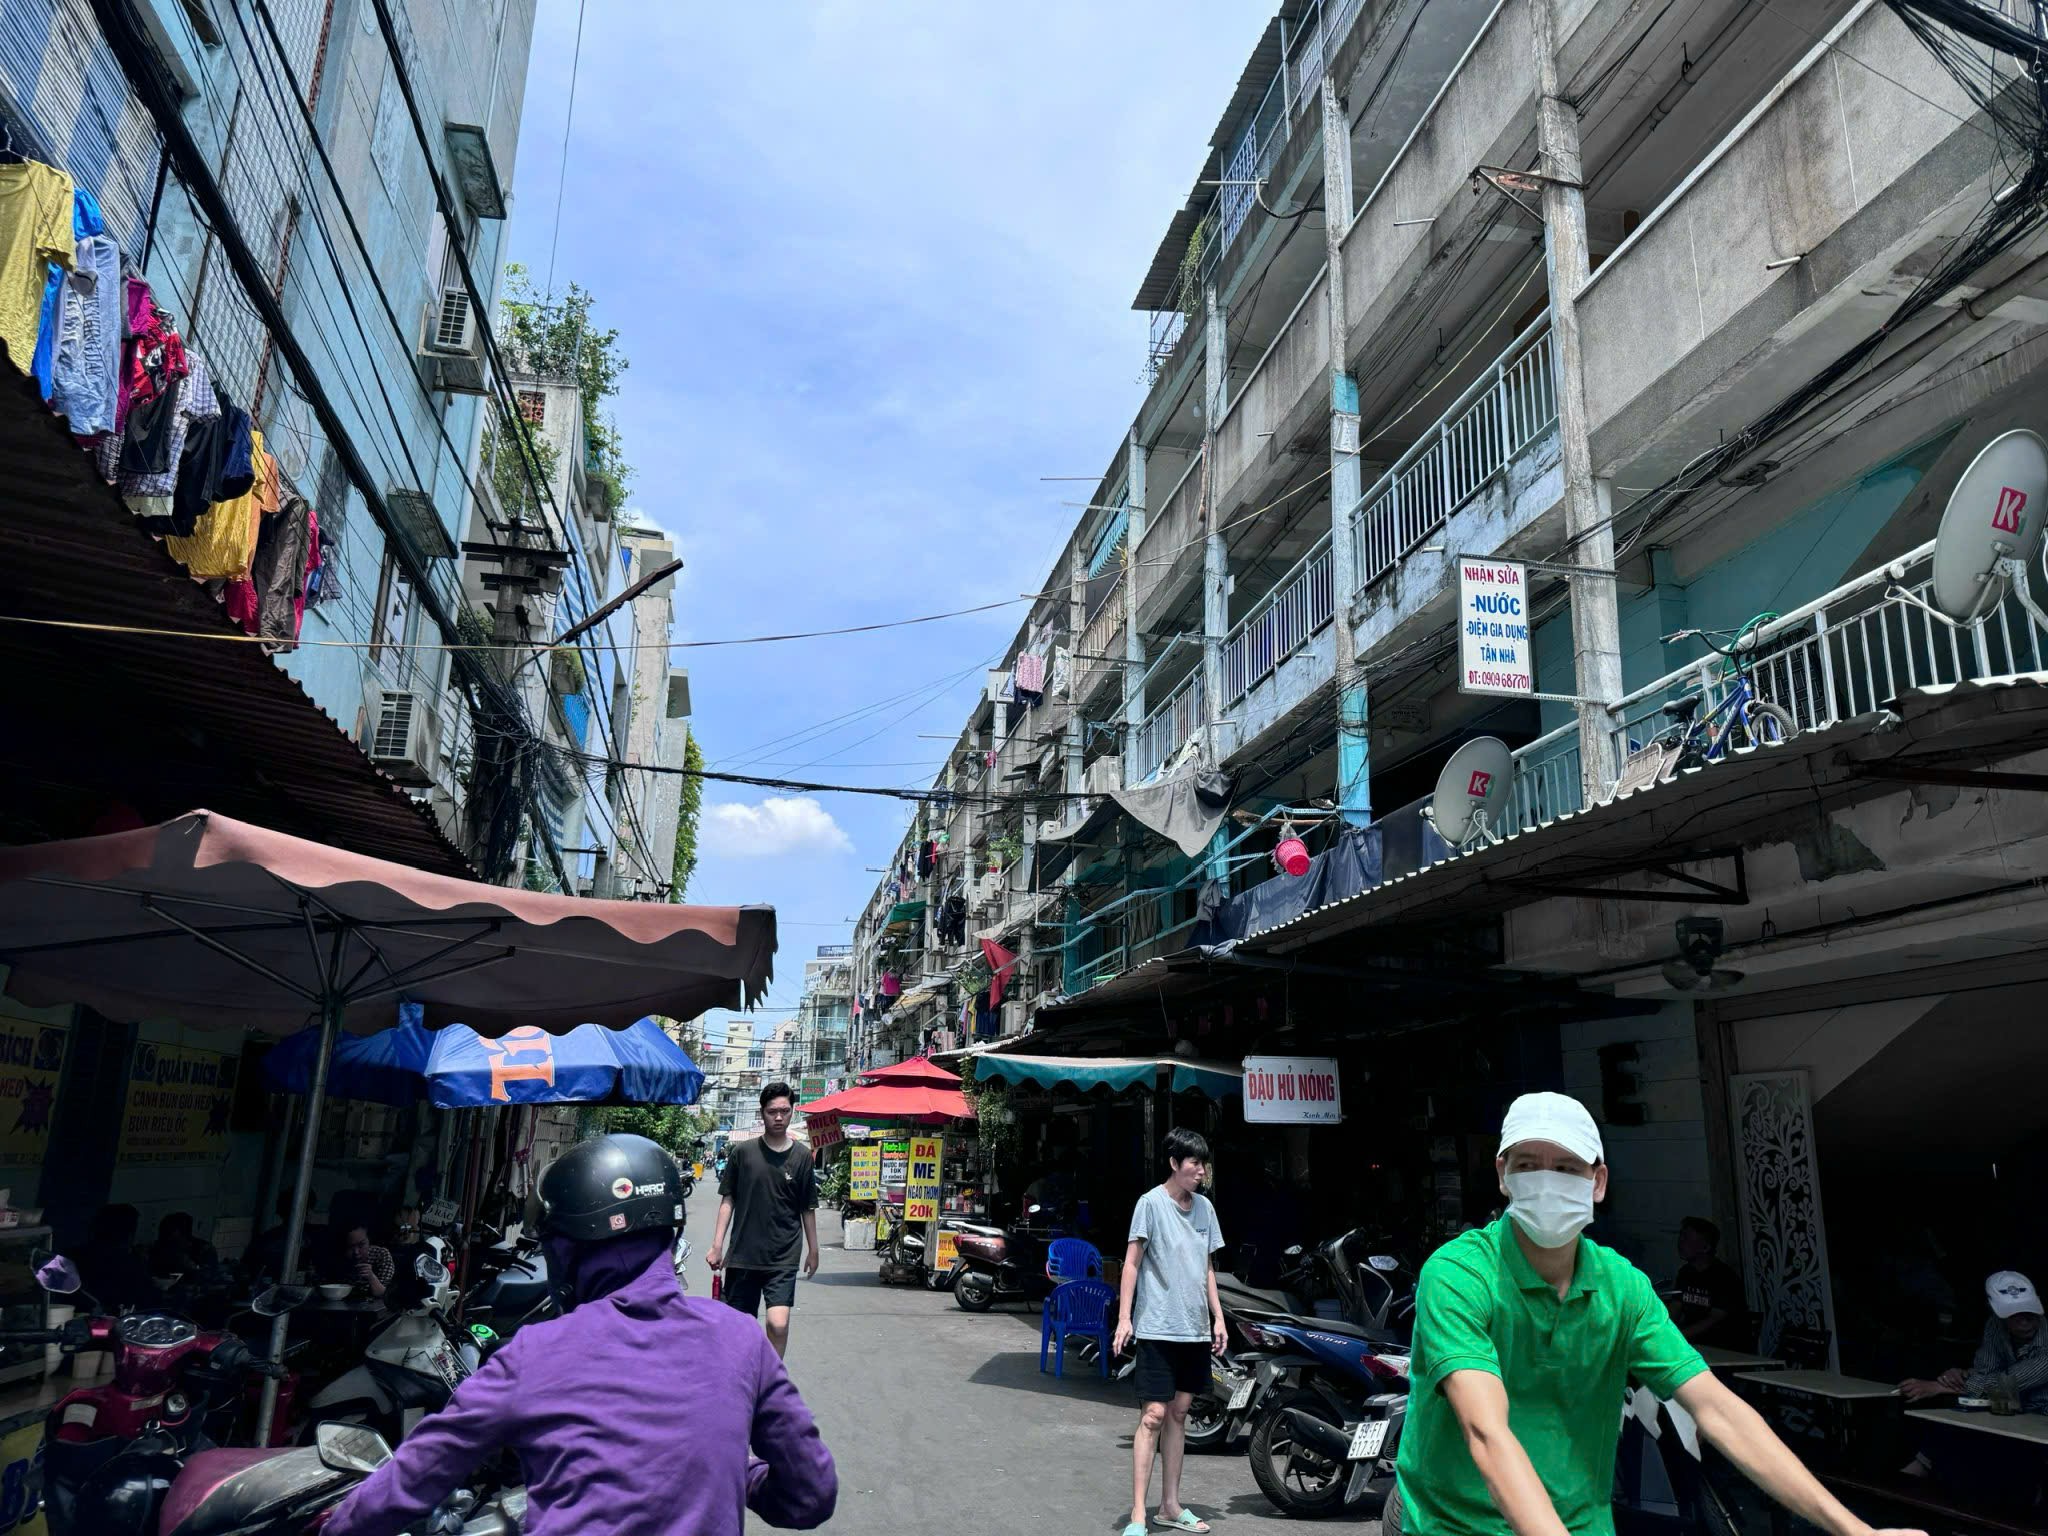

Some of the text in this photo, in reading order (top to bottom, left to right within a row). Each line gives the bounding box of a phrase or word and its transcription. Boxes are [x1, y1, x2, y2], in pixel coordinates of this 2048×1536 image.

[1464, 564, 1520, 585] NHẬN SỬA
[1490, 622, 1504, 637] GIA
[1506, 624, 1528, 643] DỤNG
[1480, 643, 1517, 664] TẬN NHÀ
[1248, 1065, 1336, 1106] ĐẬU HỦ NÓNG
[809, 1114, 837, 1130] MILO
[915, 1142, 936, 1158] ĐÁ
[913, 1162, 936, 1179] ME
[1306, 1331, 1348, 1345] VISION
